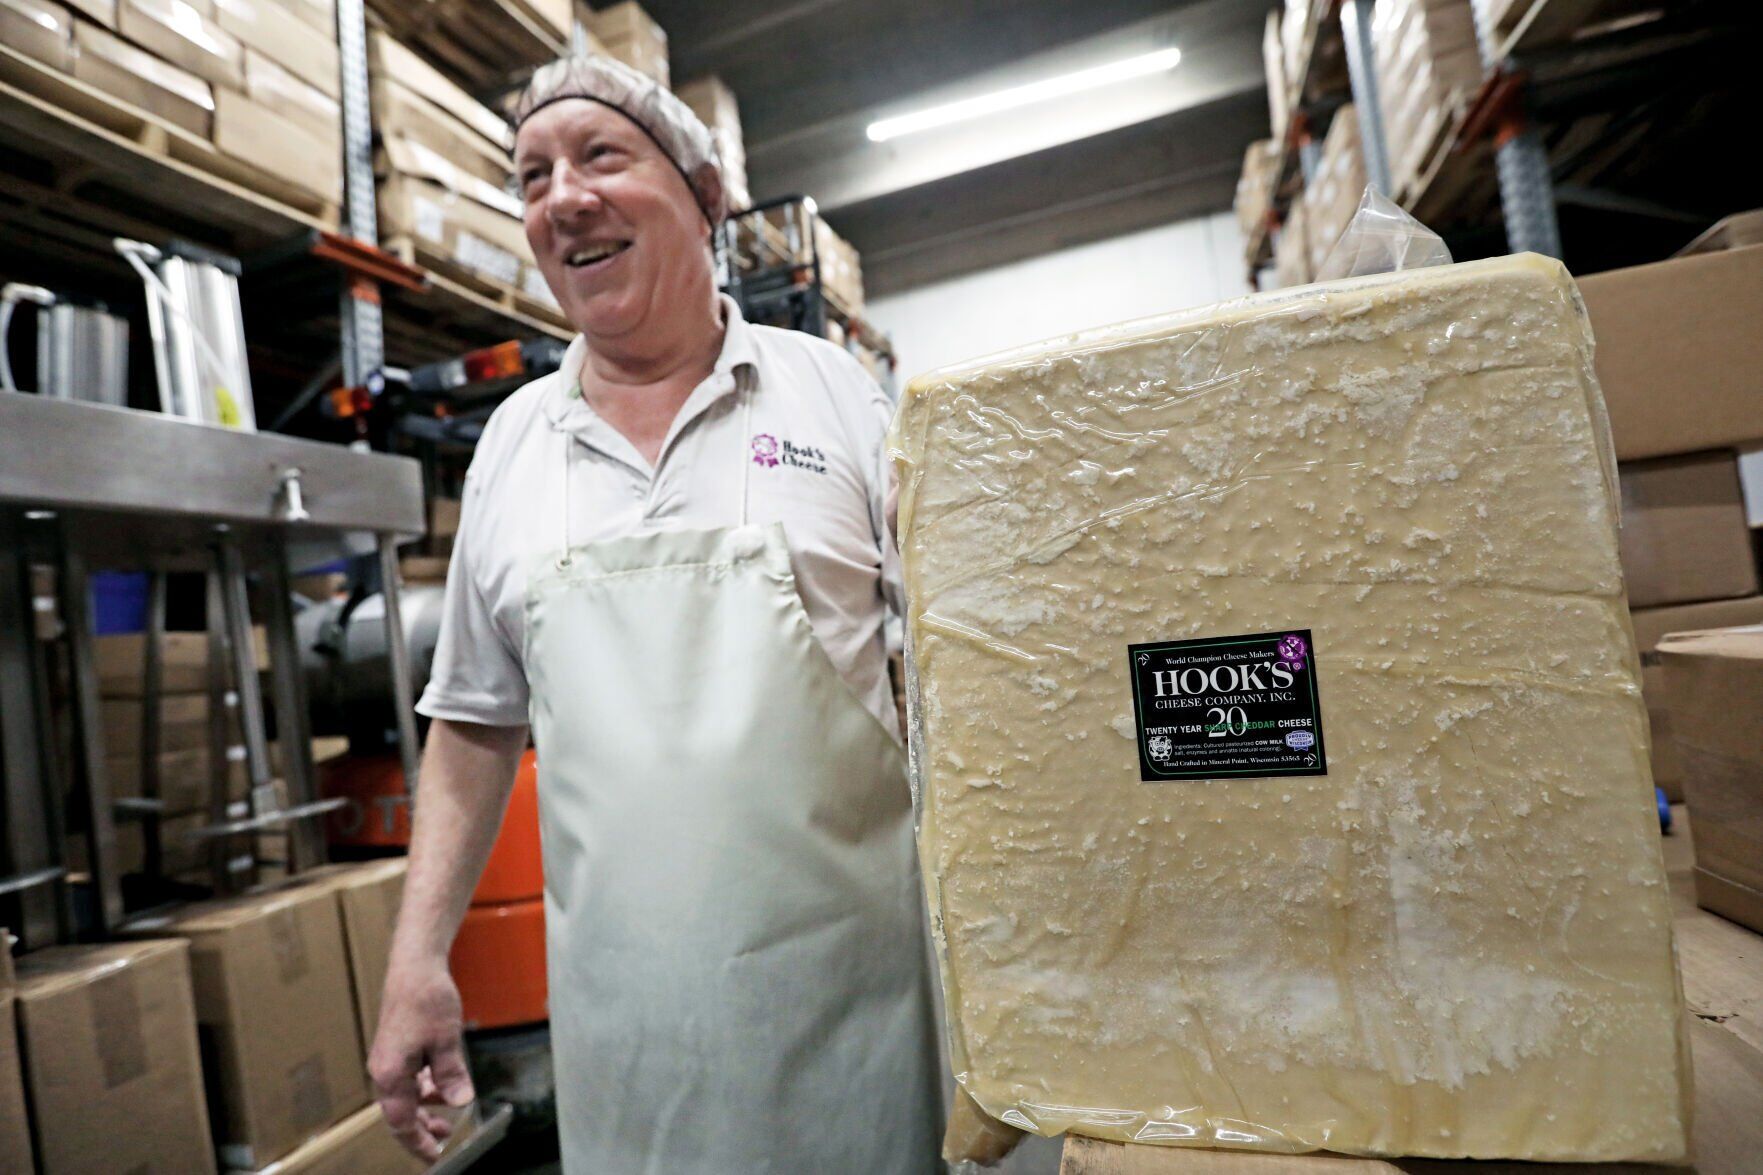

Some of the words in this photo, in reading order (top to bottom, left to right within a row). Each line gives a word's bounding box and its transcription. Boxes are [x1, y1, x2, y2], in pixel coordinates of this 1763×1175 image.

[783, 440, 825, 461] Hook's
[782, 453, 828, 475] Cheese
[1165, 657, 1186, 665] World
[1187, 655, 1222, 664] Champion
[1223, 652, 1248, 661] Cheese
[1249, 650, 1275, 659] Makers
[1155, 697, 1202, 709] CHEESE
[1270, 691, 1296, 702] INC.
[1145, 726, 1178, 735] TWENTY
[1180, 724, 1202, 733] YEAR
[1204, 722, 1233, 732] SHARP
[1234, 720, 1276, 730] CHEDDAR
[1278, 718, 1313, 728] CHEESE
[1206, 706, 1248, 737] 20
